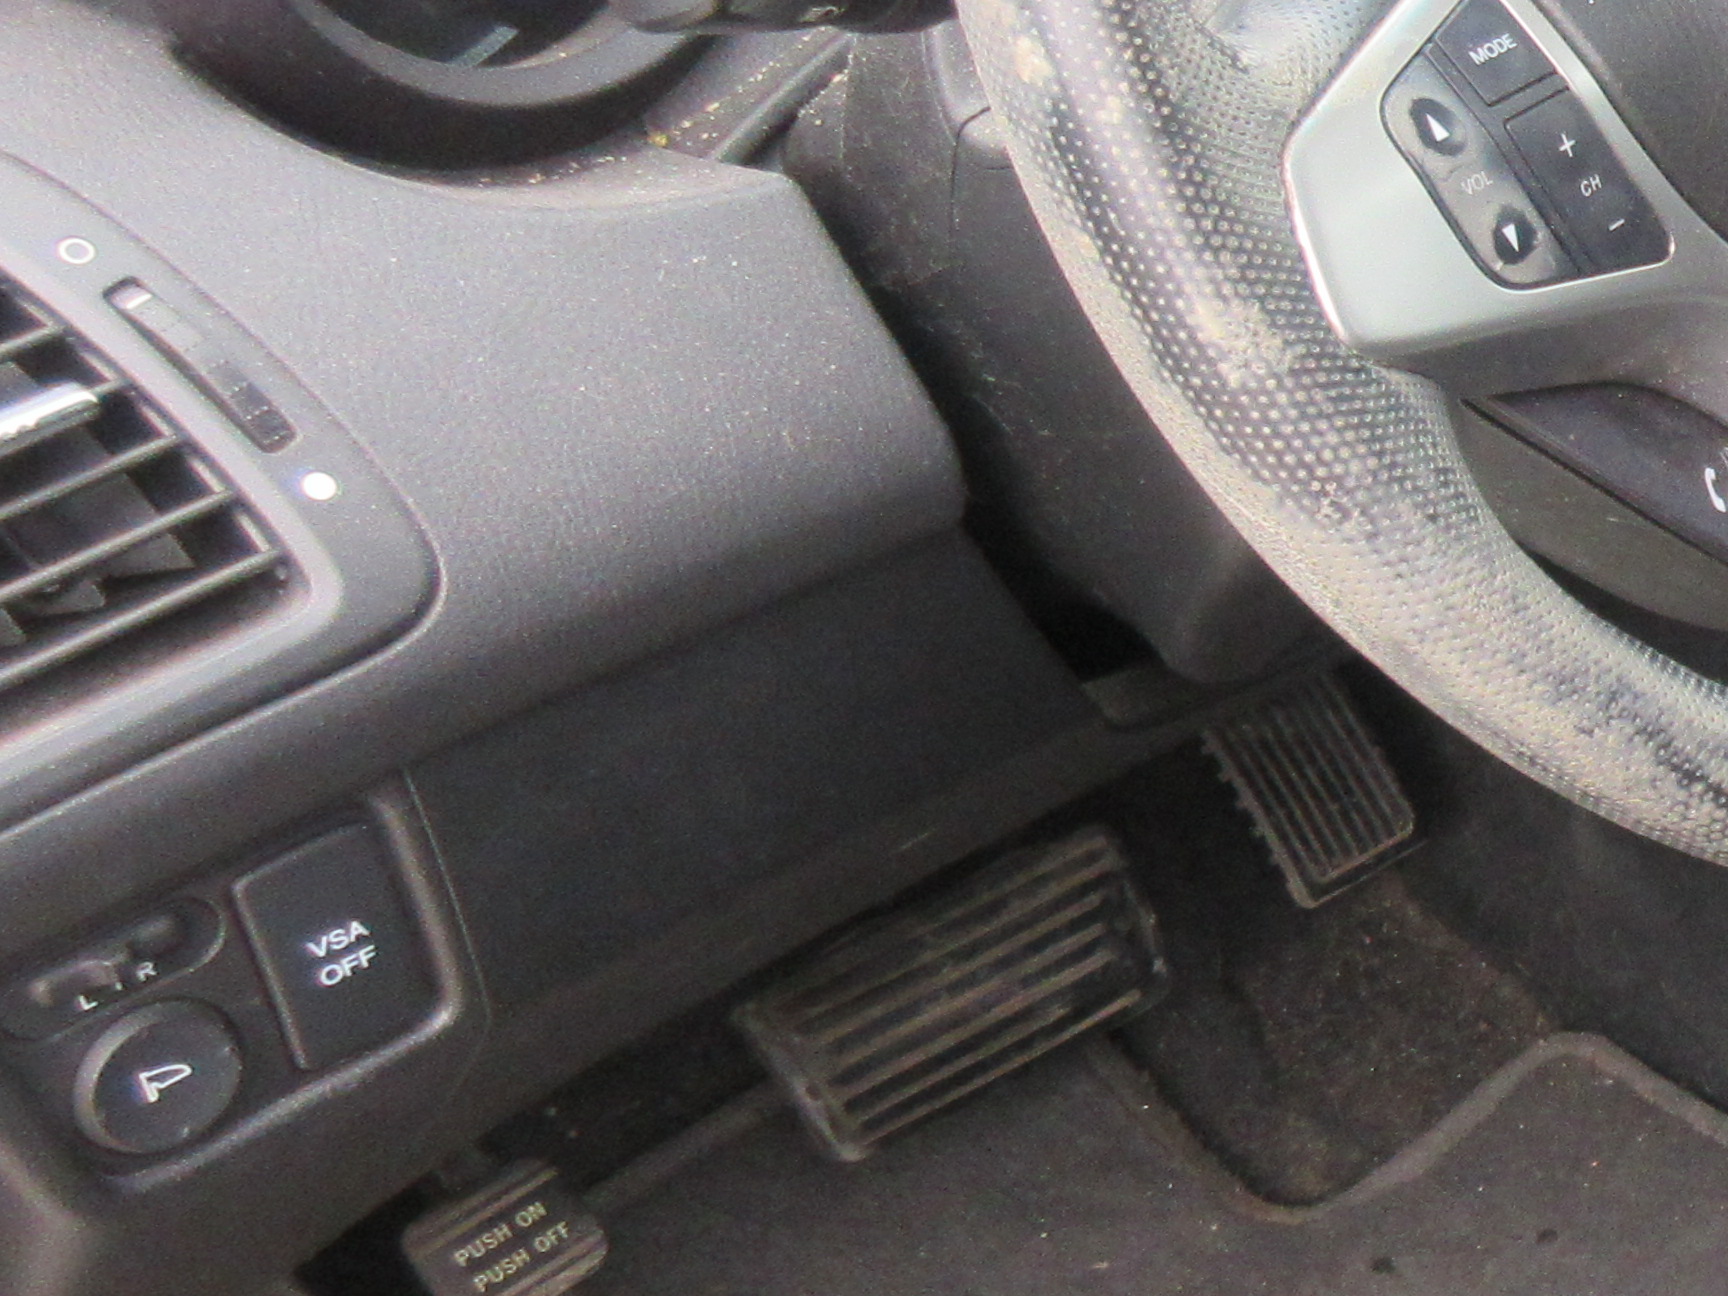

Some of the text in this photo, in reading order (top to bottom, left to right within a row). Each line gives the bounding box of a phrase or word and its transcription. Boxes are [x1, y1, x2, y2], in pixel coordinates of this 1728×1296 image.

[1468, 33, 1517, 66] MODE
[1460, 171, 1494, 195] VOL
[1580, 174, 1602, 197] CH
[306, 920, 370, 959] VSA
[135, 961, 158, 982] R
[318, 945, 379, 988] OFF
[78, 994, 98, 1012] L
[453, 1201, 548, 1267] PUSH ON
[473, 1220, 570, 1292] PUSH OFF
